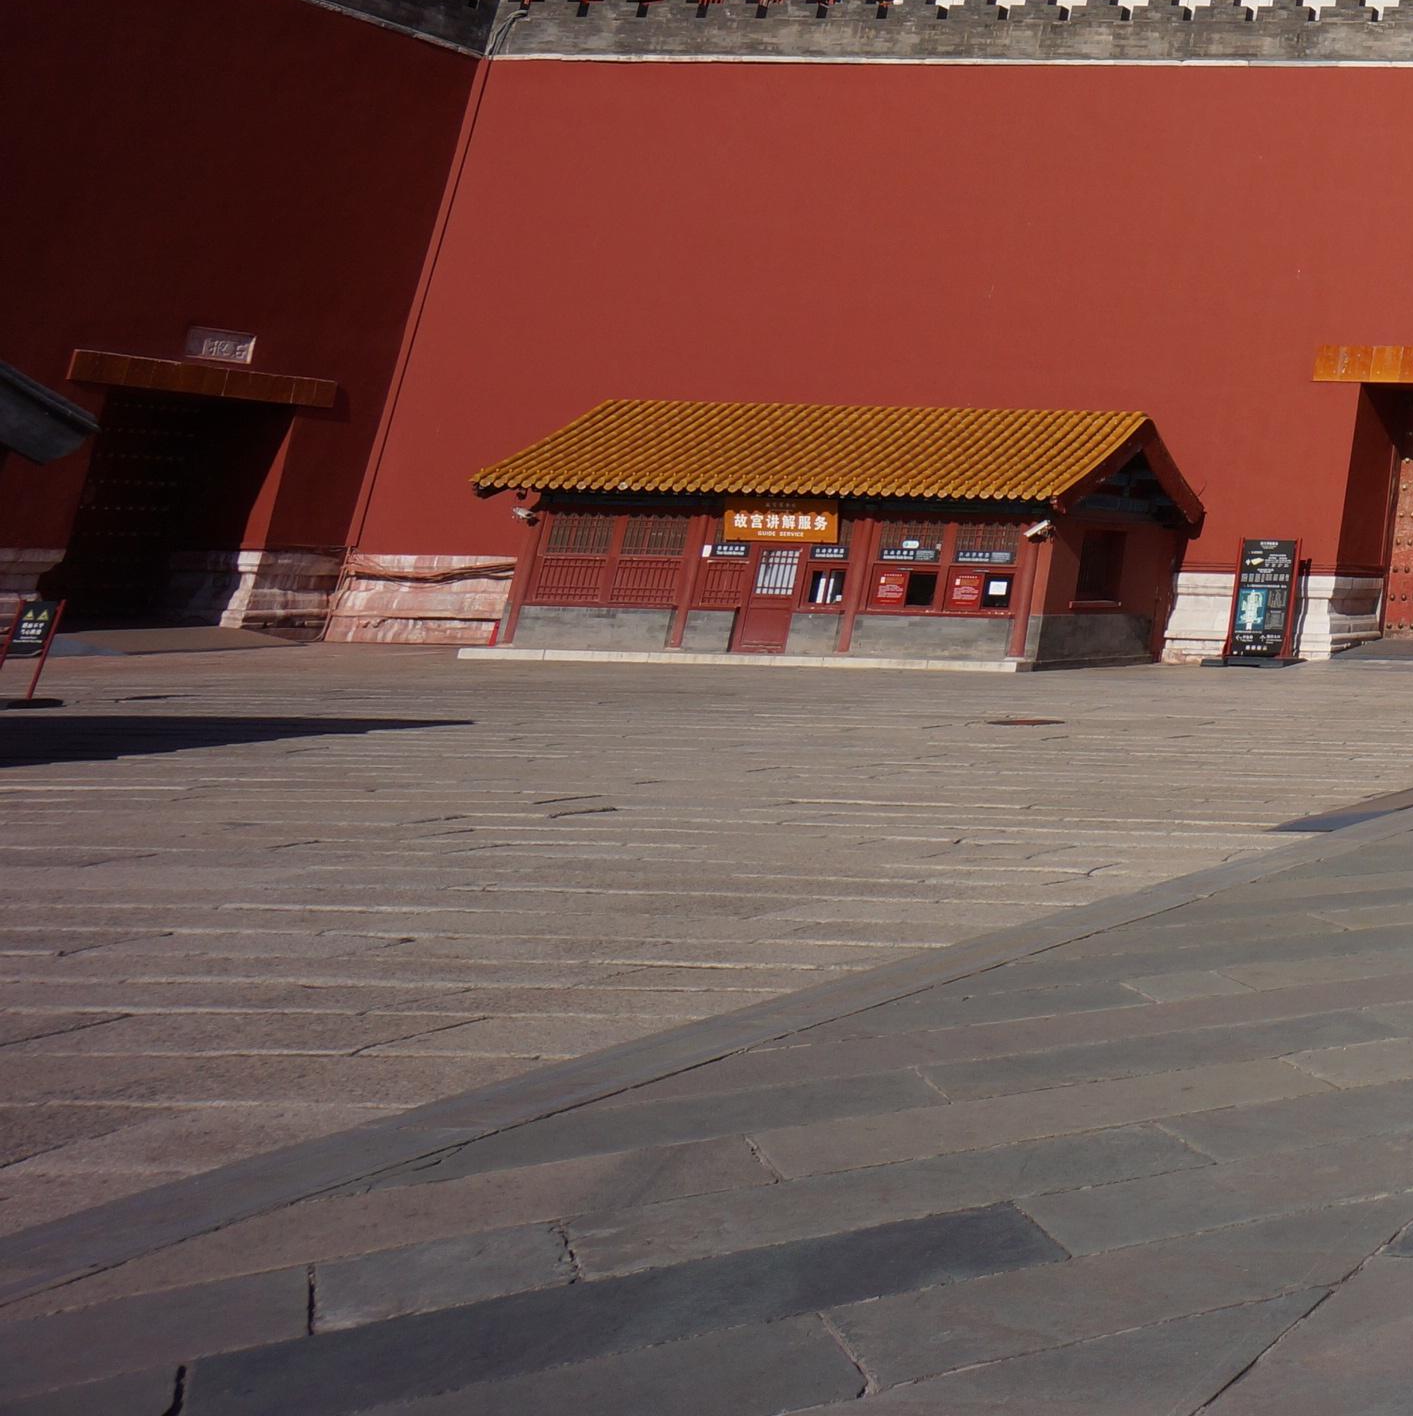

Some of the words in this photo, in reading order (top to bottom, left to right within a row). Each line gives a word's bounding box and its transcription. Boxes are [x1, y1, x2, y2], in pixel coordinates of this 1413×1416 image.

[734, 513, 828, 531] 故宫讲解服务
